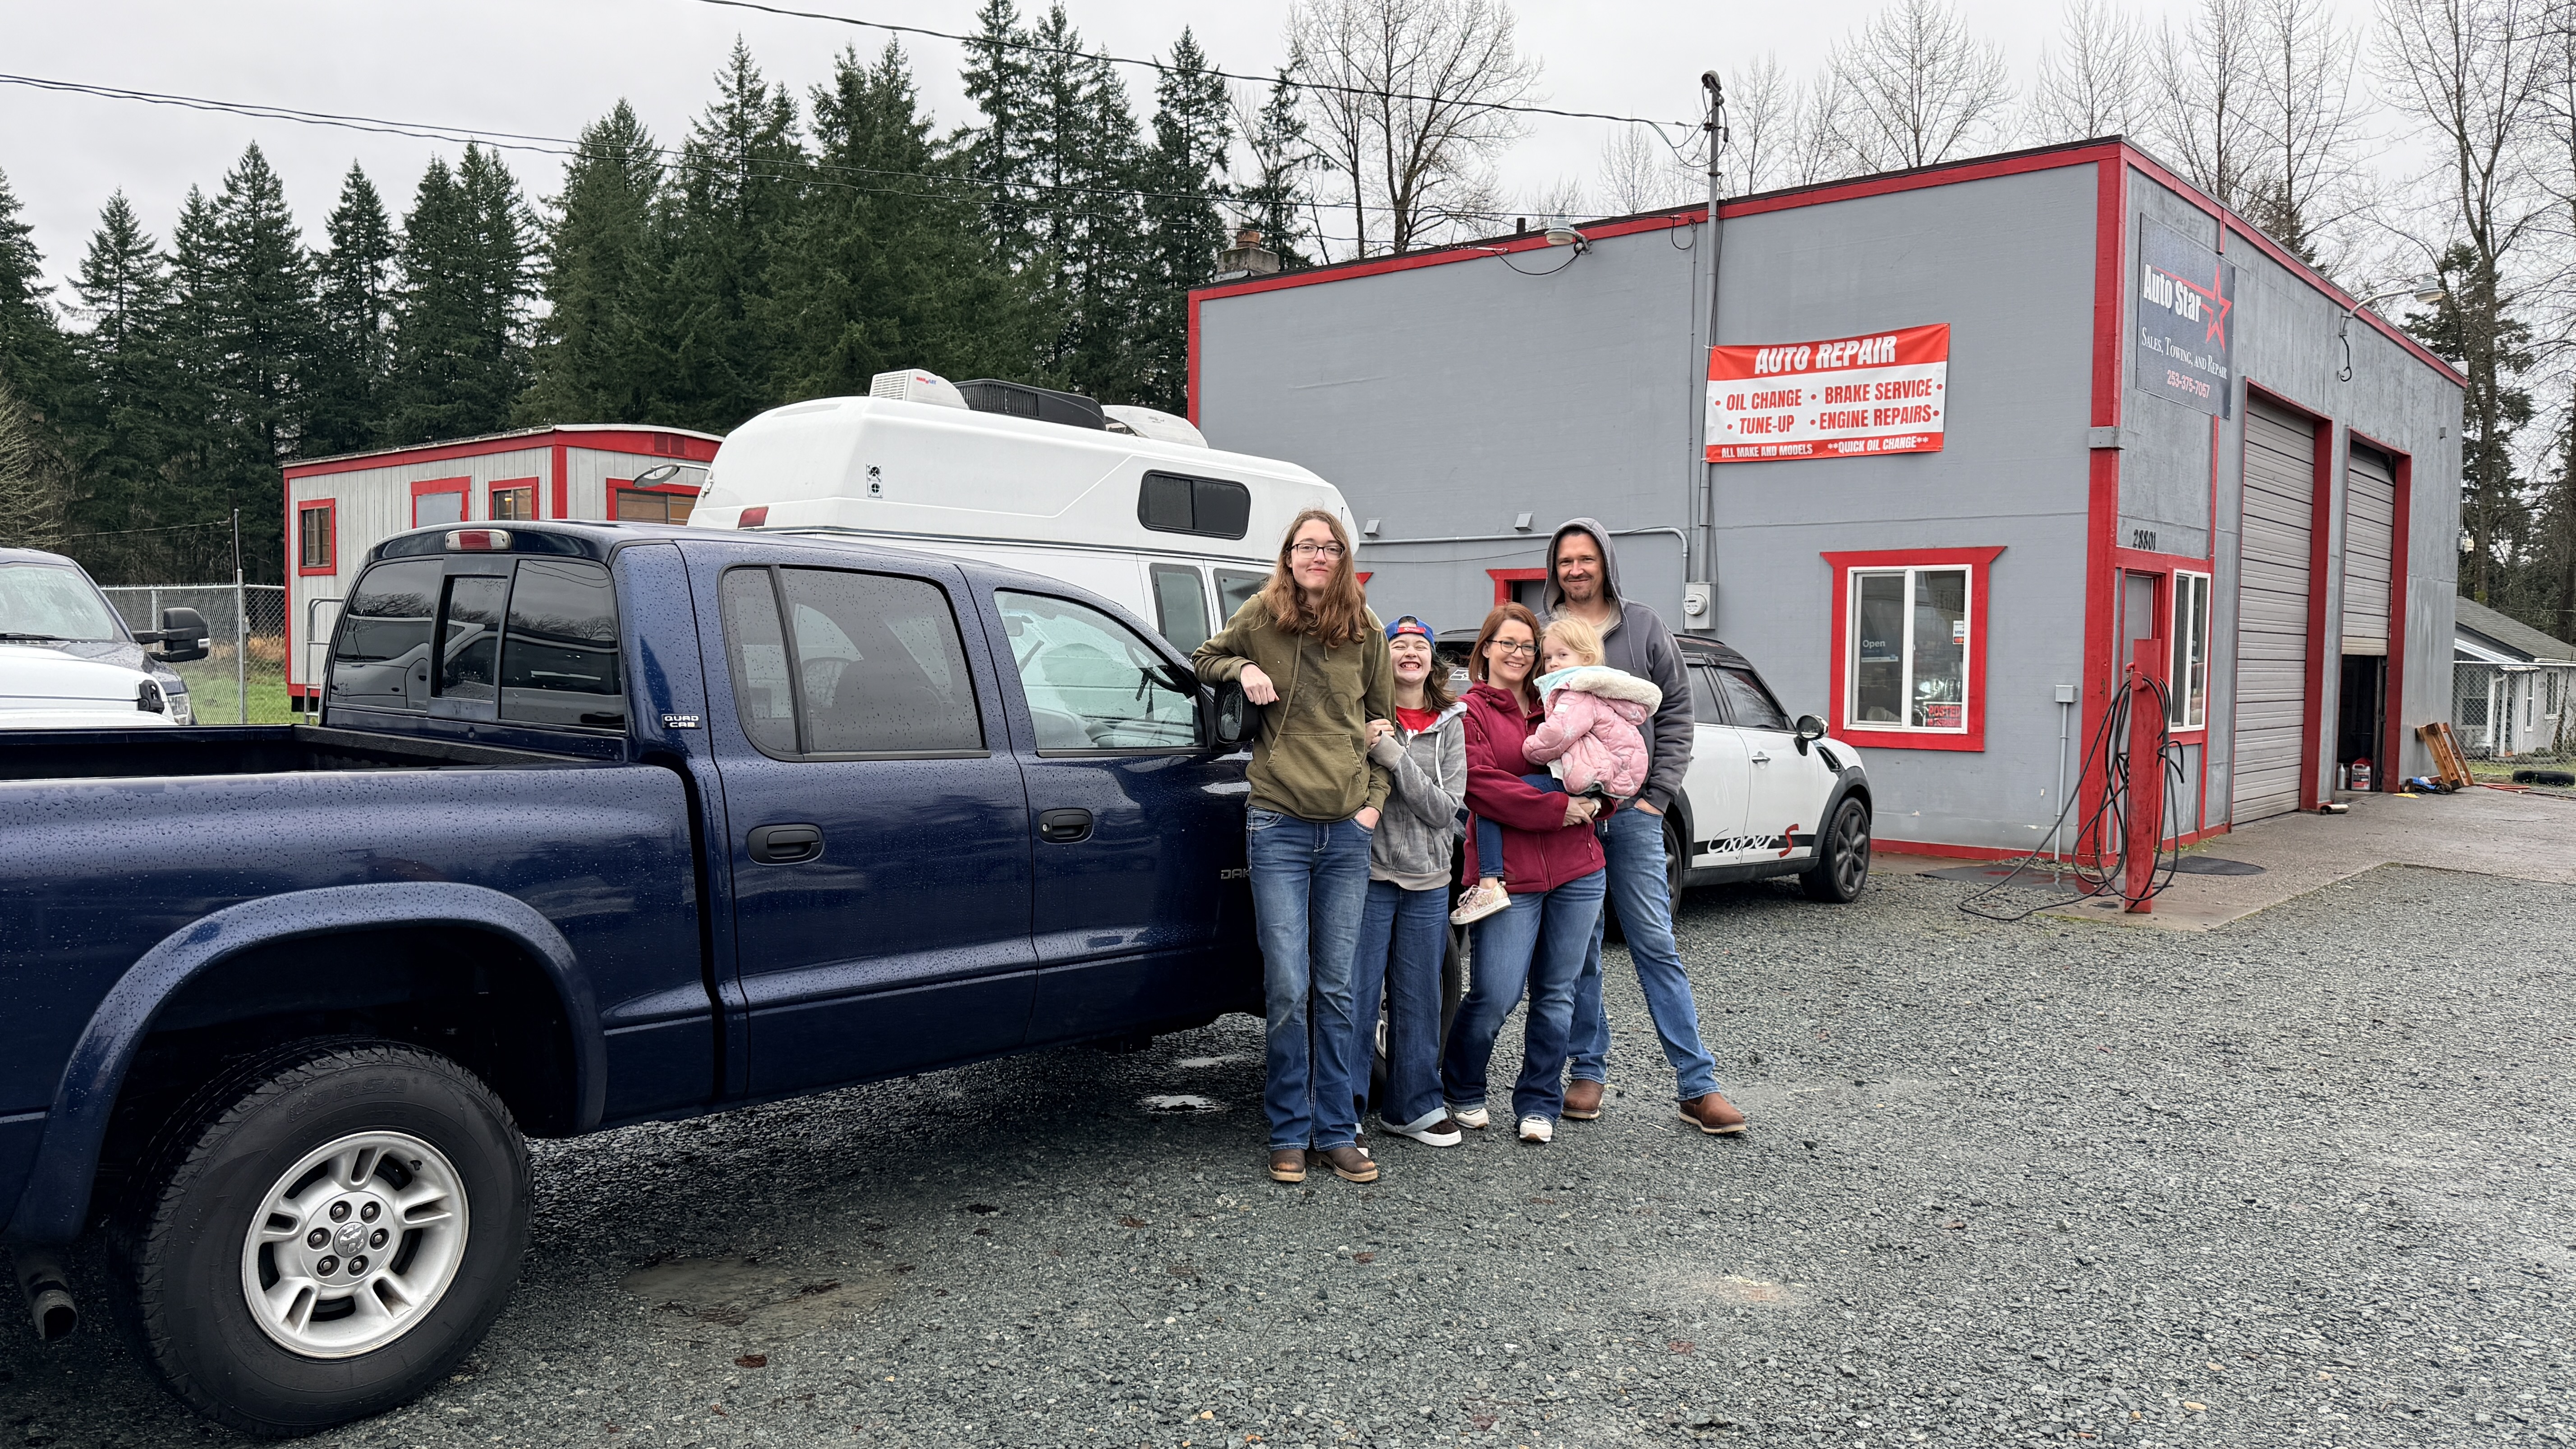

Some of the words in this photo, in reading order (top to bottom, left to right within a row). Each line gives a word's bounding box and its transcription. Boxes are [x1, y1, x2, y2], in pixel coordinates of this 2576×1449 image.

[2144, 264, 2172, 309] Auto
[2175, 280, 2201, 322] Star
[1754, 345, 1811, 374] AUTO
[1815, 336, 1897, 369] REPAIR
[1825, 383, 1870, 404] BRAKE
[1875, 378, 1933, 401] SERVICE
[2167, 369, 2210, 398] 253-375-7057
[1726, 393, 1747, 411] OIL
[1751, 389, 1802, 409] CHANGE
[1739, 414, 1794, 434] TUNE-UP
[1819, 409, 1869, 430] ENGINE
[1873, 404, 1932, 427] REPAIRS
[1721, 447, 1735, 458] ALL
[1737, 446, 1759, 458] MAKE
[1761, 446, 1777, 457] AND
[1779, 443, 1813, 456] MODELS
[1867, 439, 1881, 451] OIL
[2133, 529, 2156, 551] 28801
[1863, 639, 1886, 649] Open
[1928, 705, 1960, 718] POSTED
[1707, 827, 1779, 860] Cooper
[1778, 823, 1799, 858] S
[1221, 868, 1250, 879] DAK
[287, 1076, 408, 1122] CORSA
